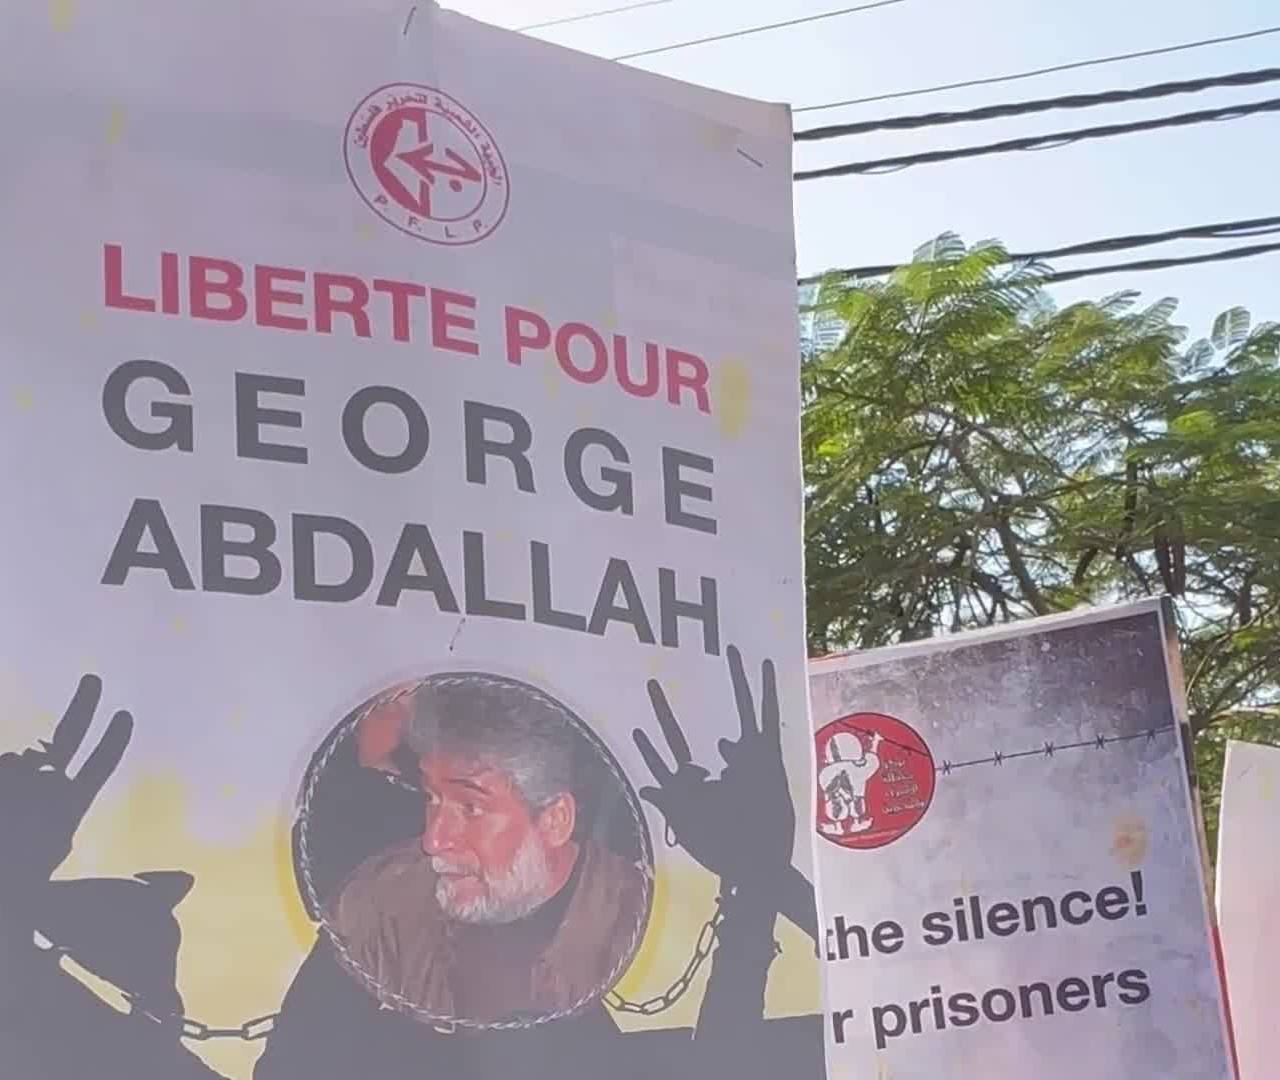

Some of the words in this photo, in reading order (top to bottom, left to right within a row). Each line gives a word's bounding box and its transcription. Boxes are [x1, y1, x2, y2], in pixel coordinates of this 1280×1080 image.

[103, 243, 479, 356] LIBERTE
[504, 304, 710, 414] POUR
[101, 358, 719, 535] GEORGE
[100, 497, 721, 657] ABDALLAH
[921, 871, 1148, 946] silence!
[872, 967, 1152, 1050] prisoners
